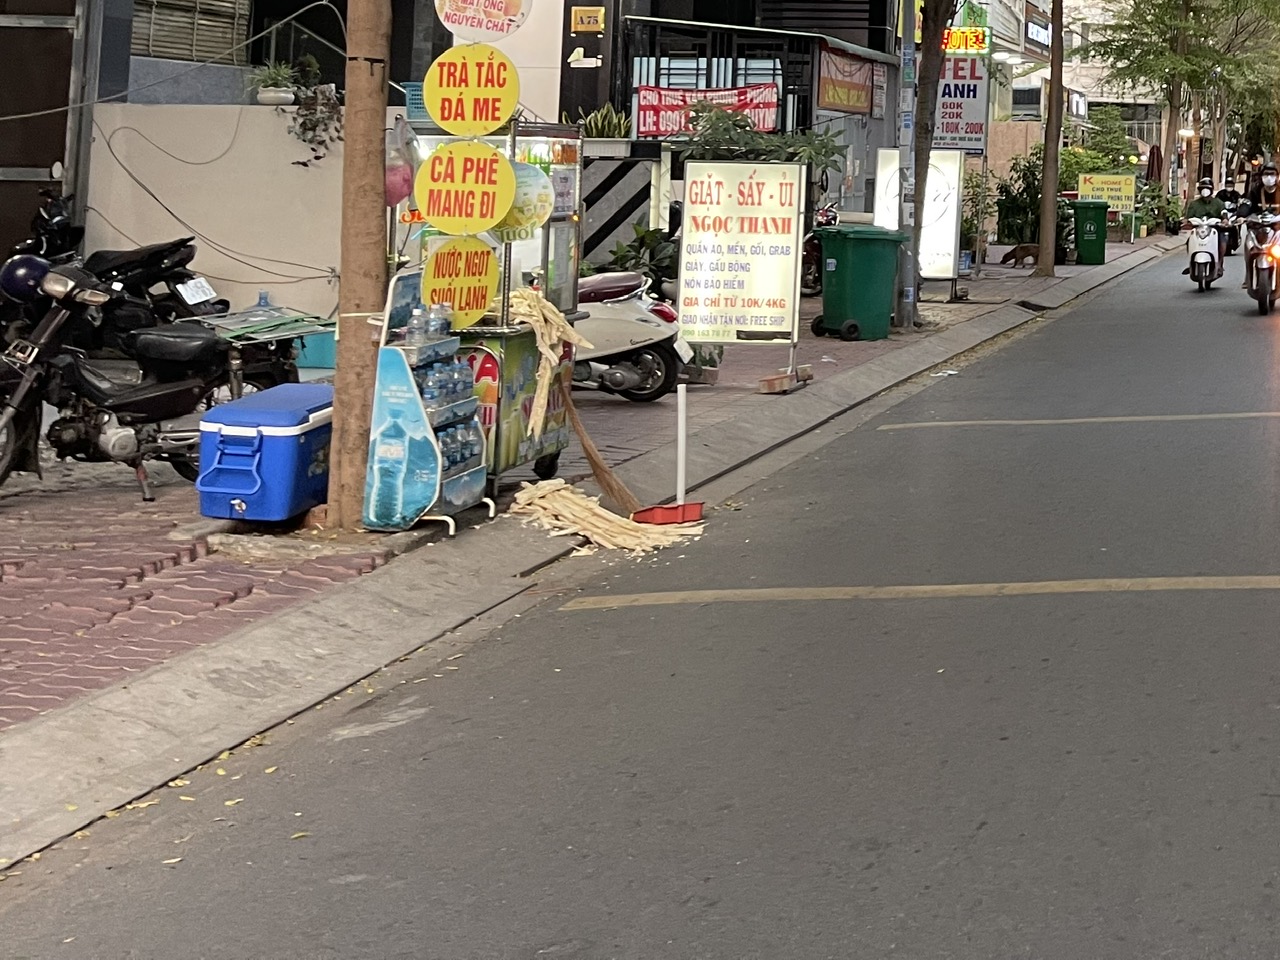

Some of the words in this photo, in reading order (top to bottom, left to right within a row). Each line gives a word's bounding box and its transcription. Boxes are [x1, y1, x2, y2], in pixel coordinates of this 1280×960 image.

[437, 56, 469, 88] TRÀ
[476, 51, 507, 88] TẮC
[940, 57, 983, 81] TEL
[640, 89, 659, 106] CHO
[942, 83, 977, 99] ANH
[440, 92, 466, 121] ĐÁ
[472, 97, 501, 122] ME
[430, 150, 455, 183] CÀ
[462, 153, 499, 186] PHÊ
[427, 189, 476, 219] MANG
[480, 191, 497, 219] ĐI
[689, 172, 725, 211] GIẶT
[737, 168, 766, 207] SẤY
[779, 171, 794, 207] ỦI
[689, 214, 733, 238] NGỌC
[737, 216, 793, 235] THANH
[433, 246, 463, 280] NƯỚC
[464, 249, 491, 283] NGỌT
[769, 245, 791, 256] GRAB
[458, 285, 489, 316] LẠNH
[750, 316, 768, 326] FREE
